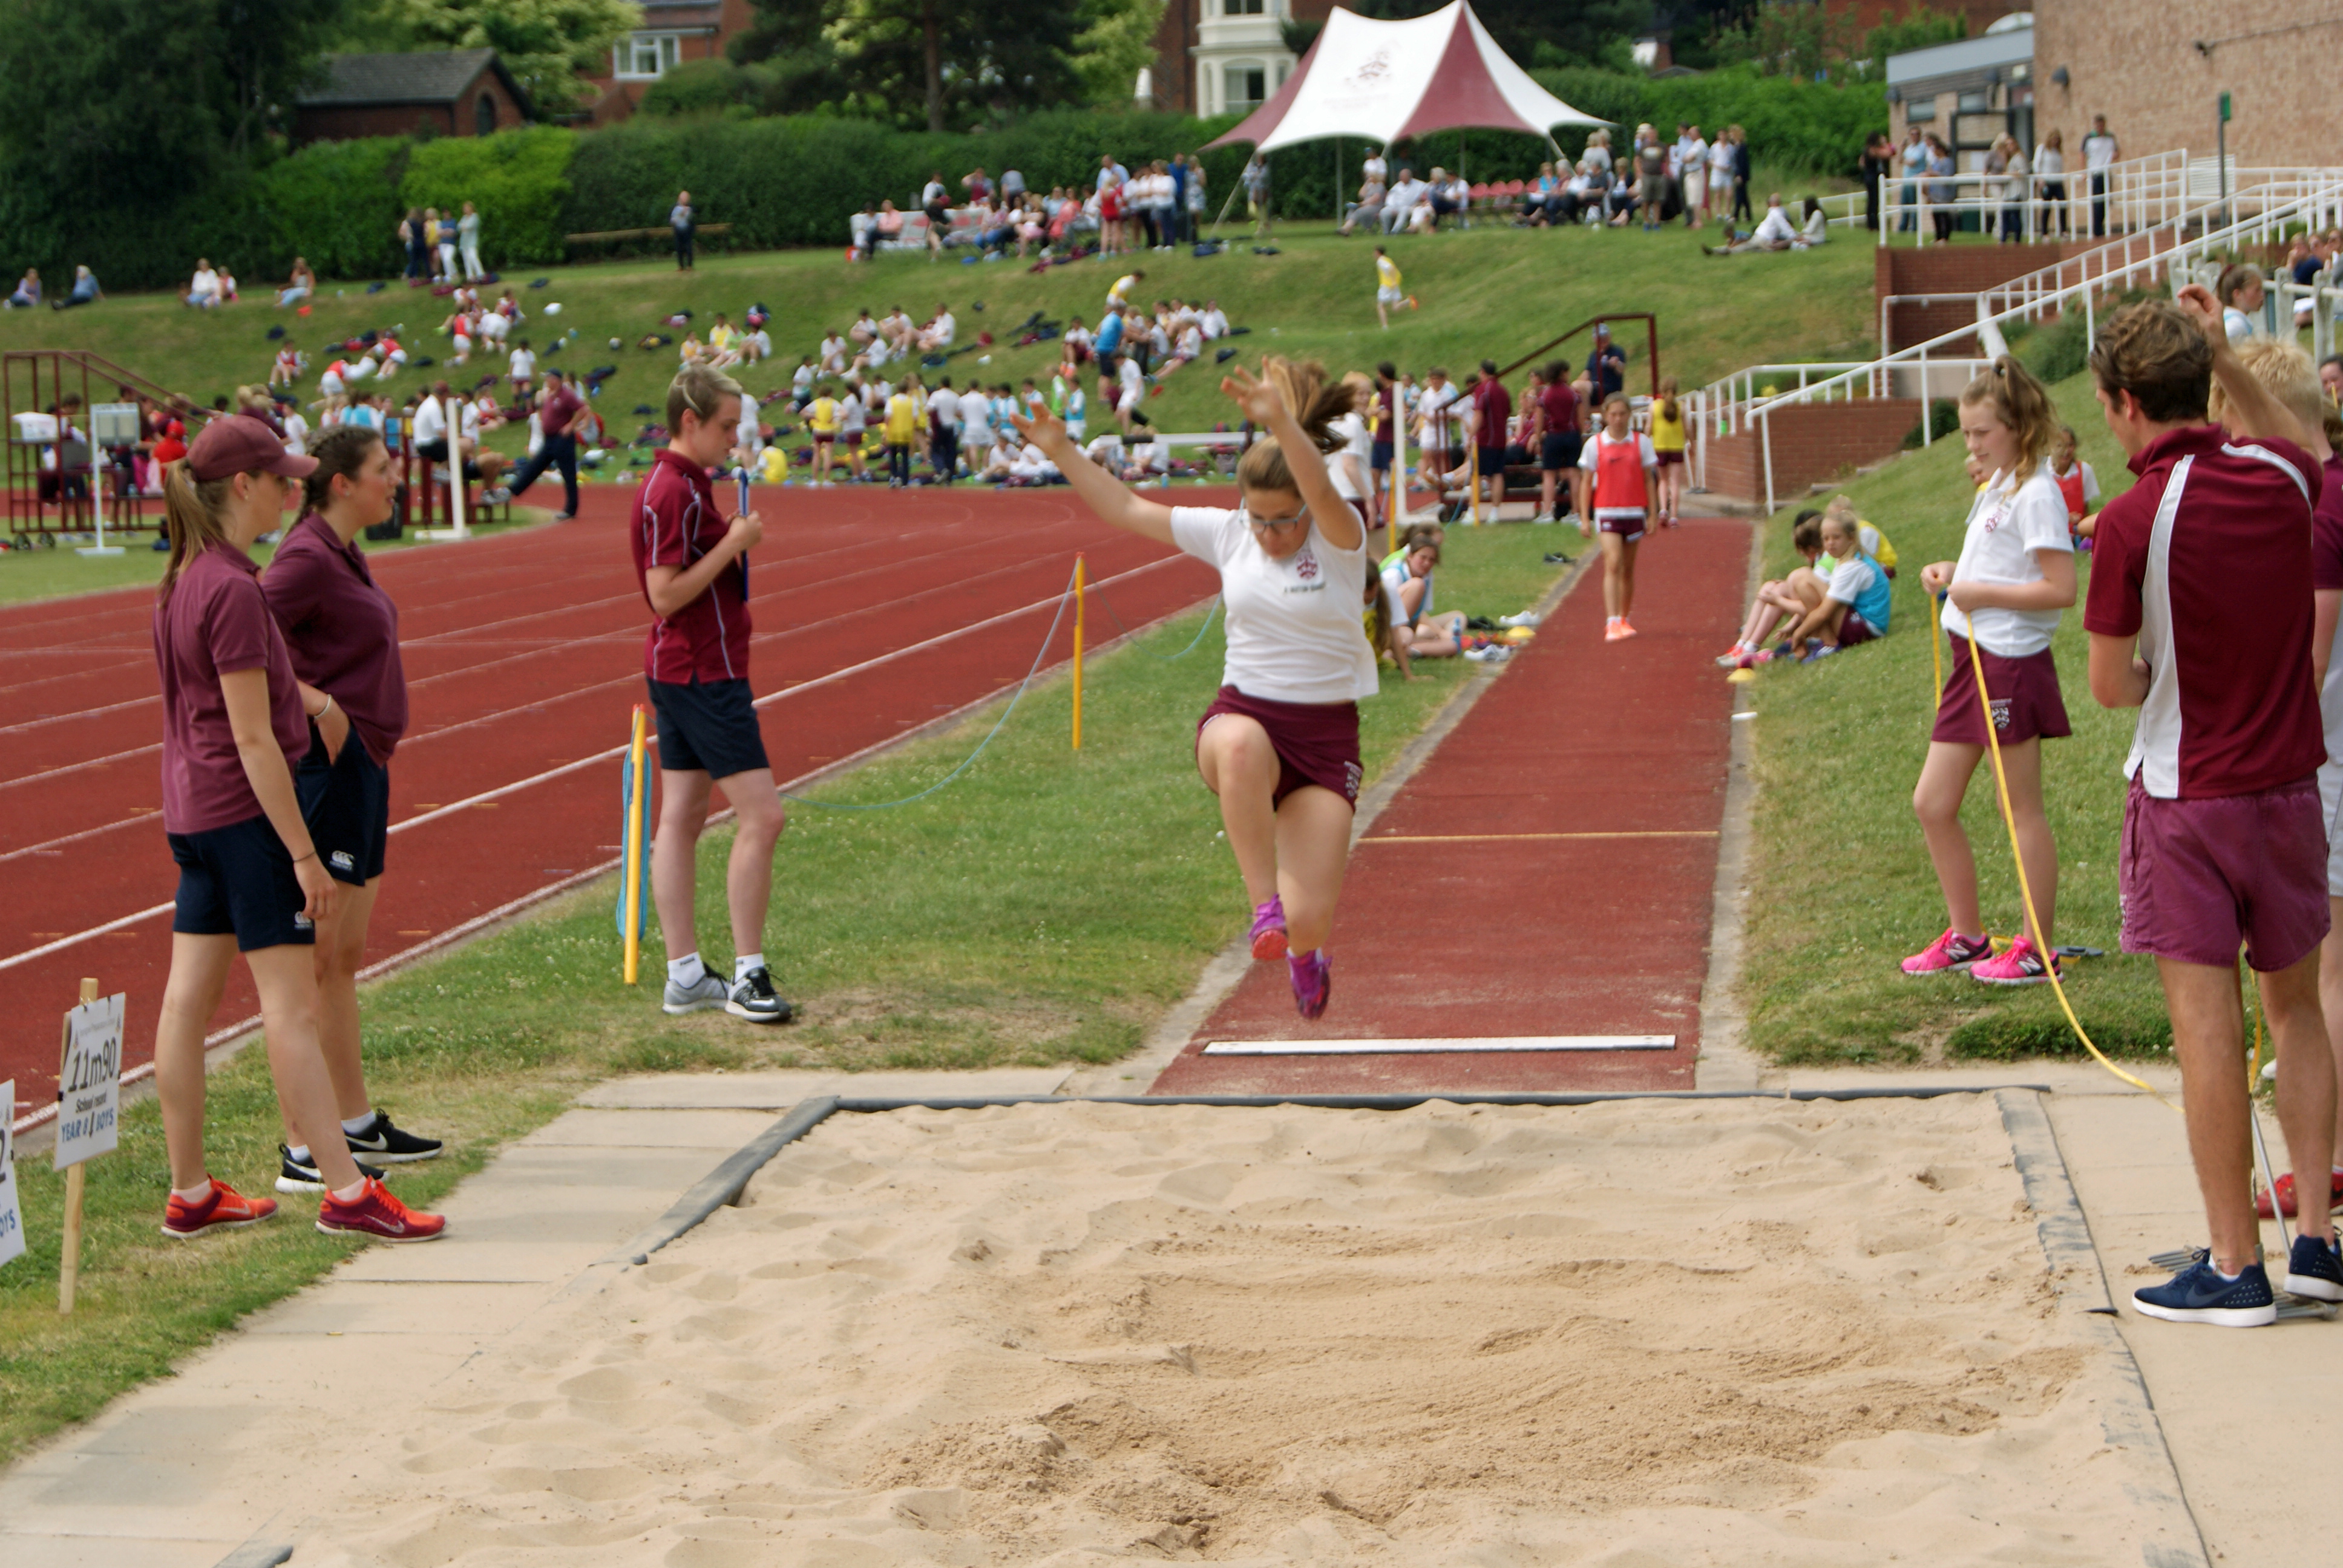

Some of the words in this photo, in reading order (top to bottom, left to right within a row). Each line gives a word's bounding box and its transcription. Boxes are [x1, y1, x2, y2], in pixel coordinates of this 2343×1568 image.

[2017, 956, 2041, 974] N
[68, 1036, 116, 1093] 11m90
[76, 1094, 94, 1112] School
[62, 1119, 82, 1143] YEAR
[96, 1106, 114, 1131] BOYS
